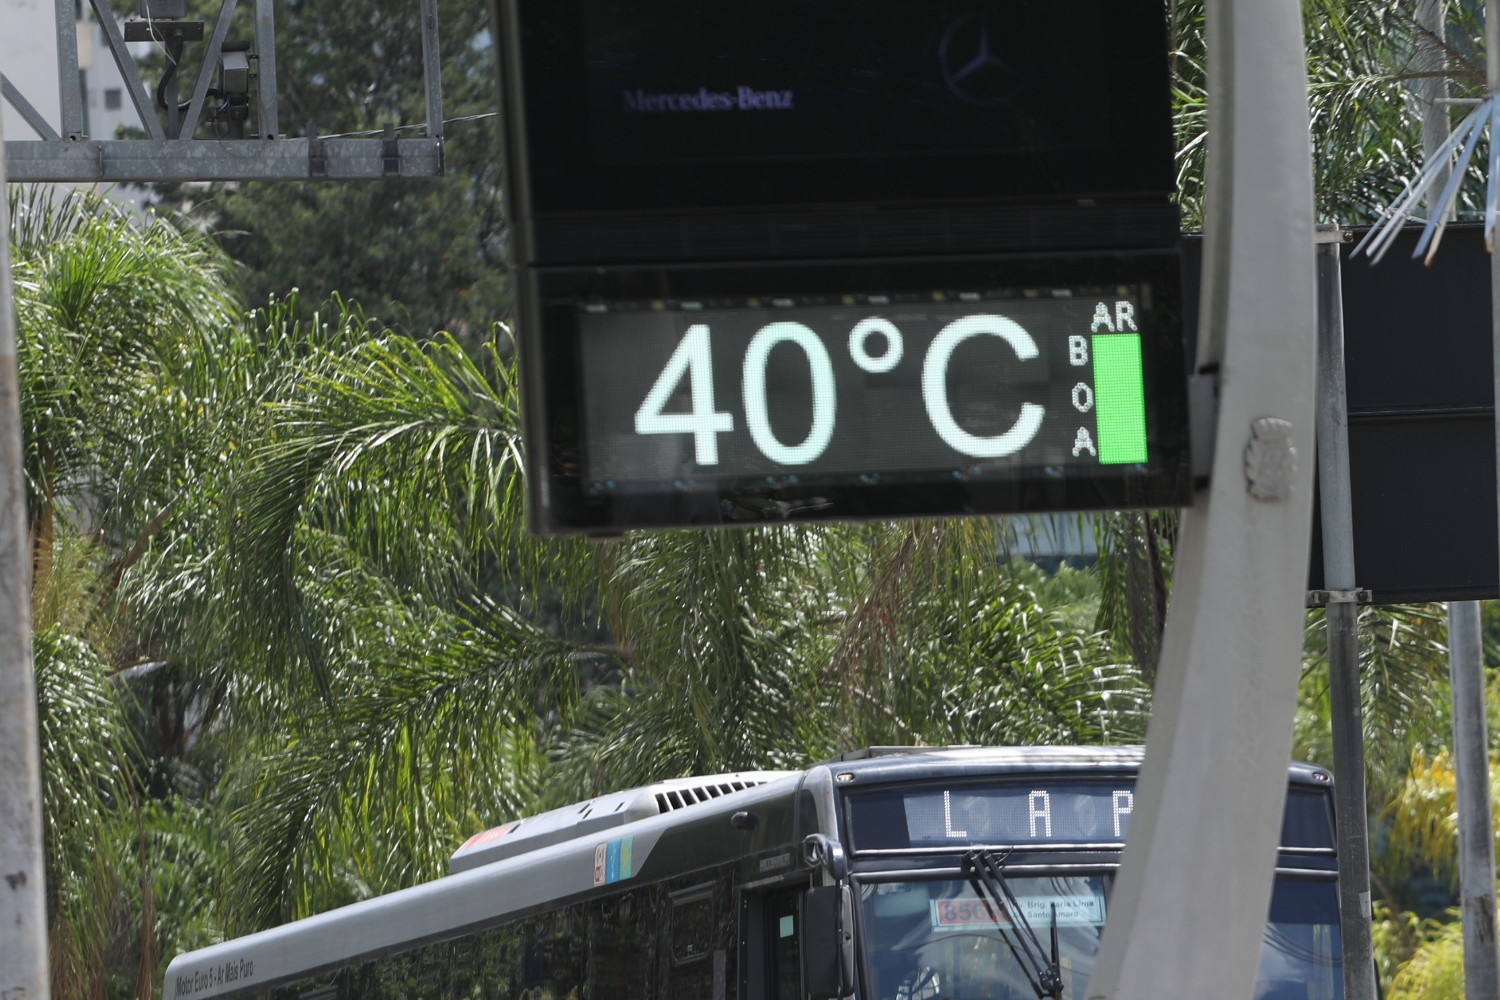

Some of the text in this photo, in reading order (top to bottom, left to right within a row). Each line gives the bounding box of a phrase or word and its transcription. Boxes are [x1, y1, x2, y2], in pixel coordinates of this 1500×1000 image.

[624, 86, 793, 112] Mercedes-Benz
[1091, 301, 1138, 332] AR
[943, 790, 1134, 837] LAP
[1050, 900, 1071, 908] aria
[176, 976, 193, 997] Motor
[195, 970, 208, 992] Euro
[217, 965, 224, 985] Ar
[225, 961, 238, 984] Mais
[240, 958, 254, 979] Puro
